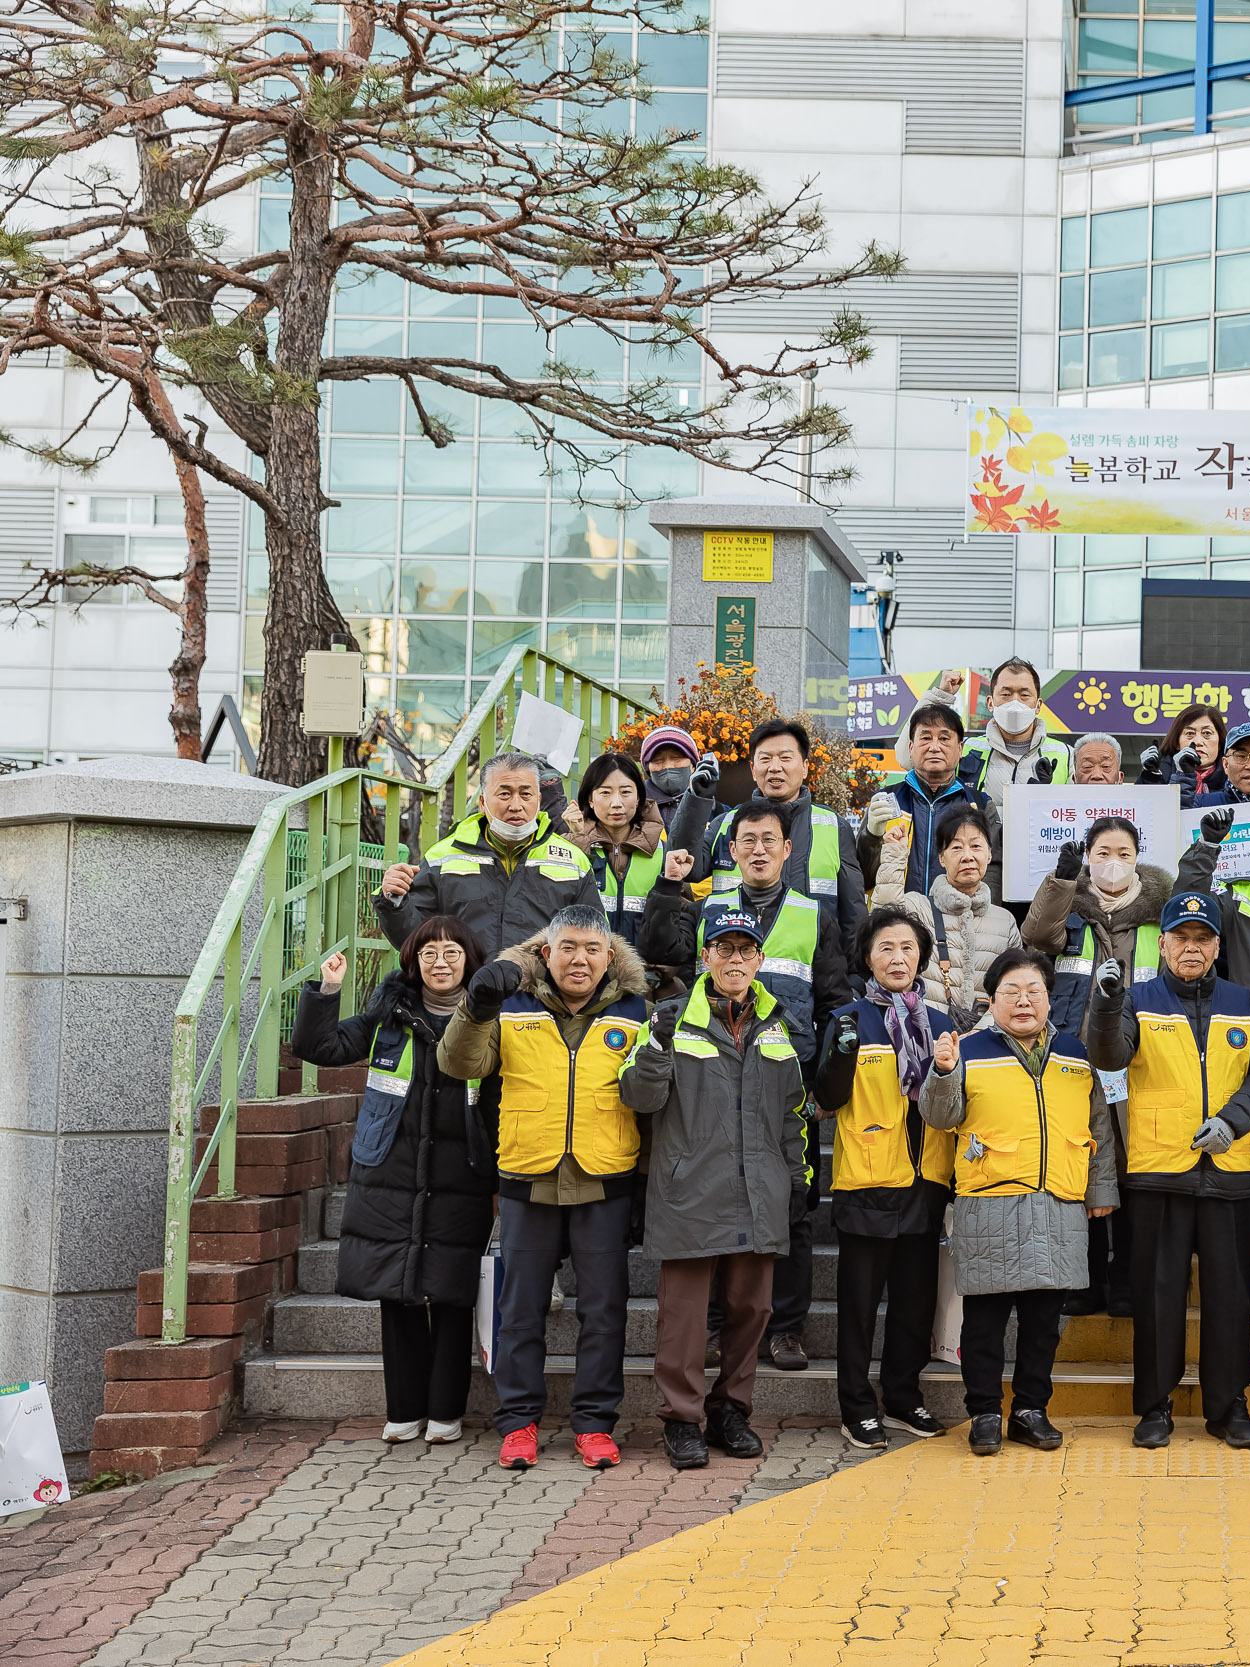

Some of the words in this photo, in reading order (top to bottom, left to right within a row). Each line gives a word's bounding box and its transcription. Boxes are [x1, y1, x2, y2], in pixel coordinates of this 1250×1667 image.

[1070, 433, 1095, 448] 설렘
[1099, 434, 1122, 448] 가득
[1126, 434, 1150, 448] 솜씨
[1154, 435, 1180, 448] 자랑
[1065, 455, 1181, 484] 늘봄학교
[711, 536, 734, 544] CCTV
[752, 537, 767, 545] 안내
[1120, 680, 1232, 725] 행복한
[1051, 808, 1077, 822] 아동
[1040, 827, 1076, 841] 예방이
[715, 913, 756, 928] CANADA
